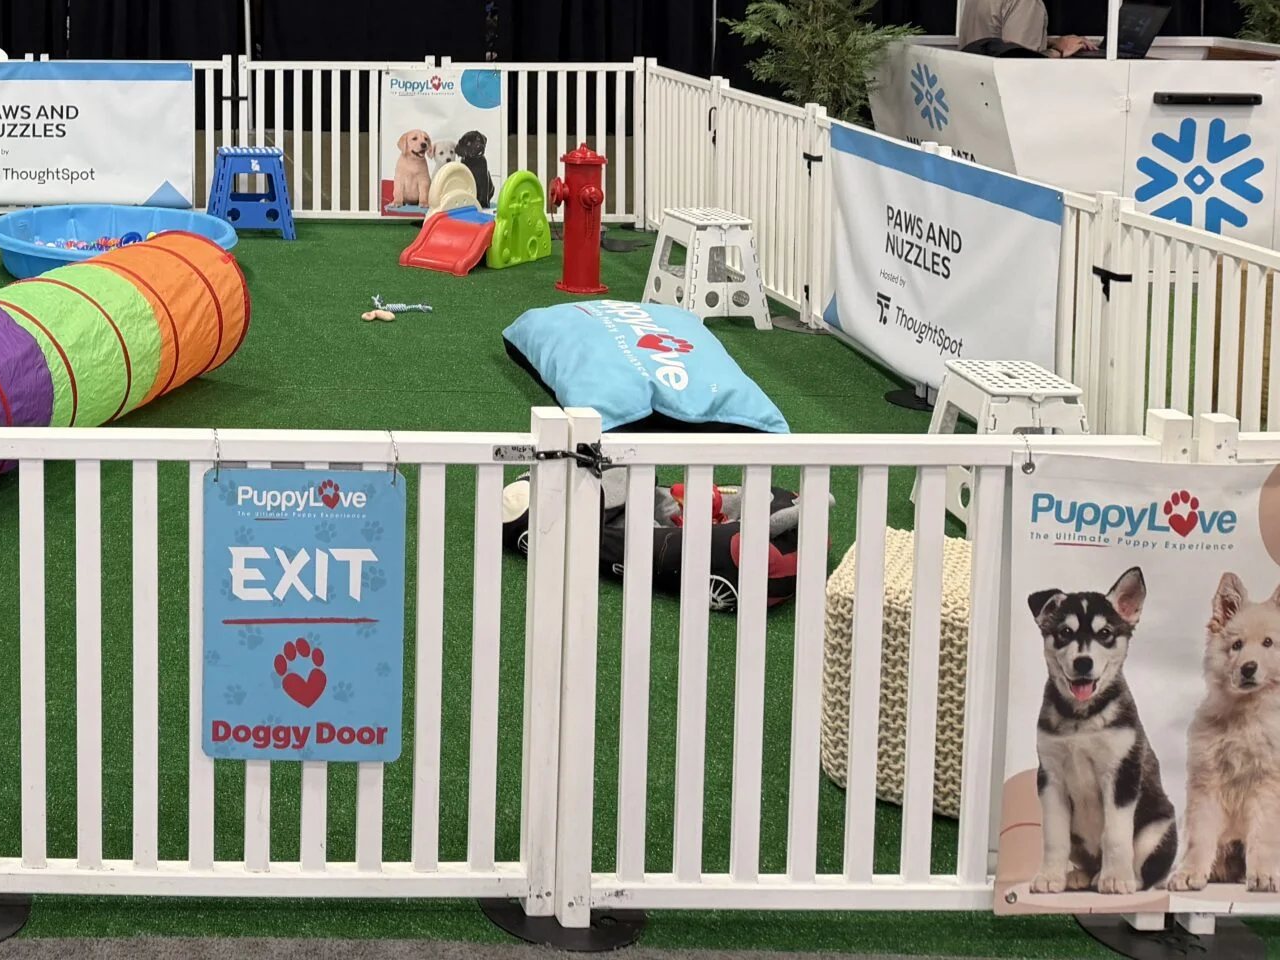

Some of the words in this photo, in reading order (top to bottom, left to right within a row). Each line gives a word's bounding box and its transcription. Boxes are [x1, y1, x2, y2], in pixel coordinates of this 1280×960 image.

[391, 75, 454, 92] PuppyLove
[36, 105, 79, 120] AND
[1, 148, 10, 156] by
[2, 168, 95, 184] ThoughtSpot
[886, 204, 923, 240] PAWS
[926, 222, 962, 254] AND
[885, 232, 951, 280] NUZZLES
[880, 268, 900, 284] Hosted
[895, 306, 963, 357] ThoughtSpot
[237, 479, 367, 511] PuppyLove
[1031, 490, 1237, 538] PuppyLove
[1030, 531, 1049, 540] The
[1056, 532, 1111, 544] Ultimate
[1117, 537, 1158, 550] Puppy
[1165, 542, 1235, 552] Experience
[228, 547, 379, 602] EXIT
[212, 720, 312, 750] Doggy
[316, 722, 388, 745] Door
